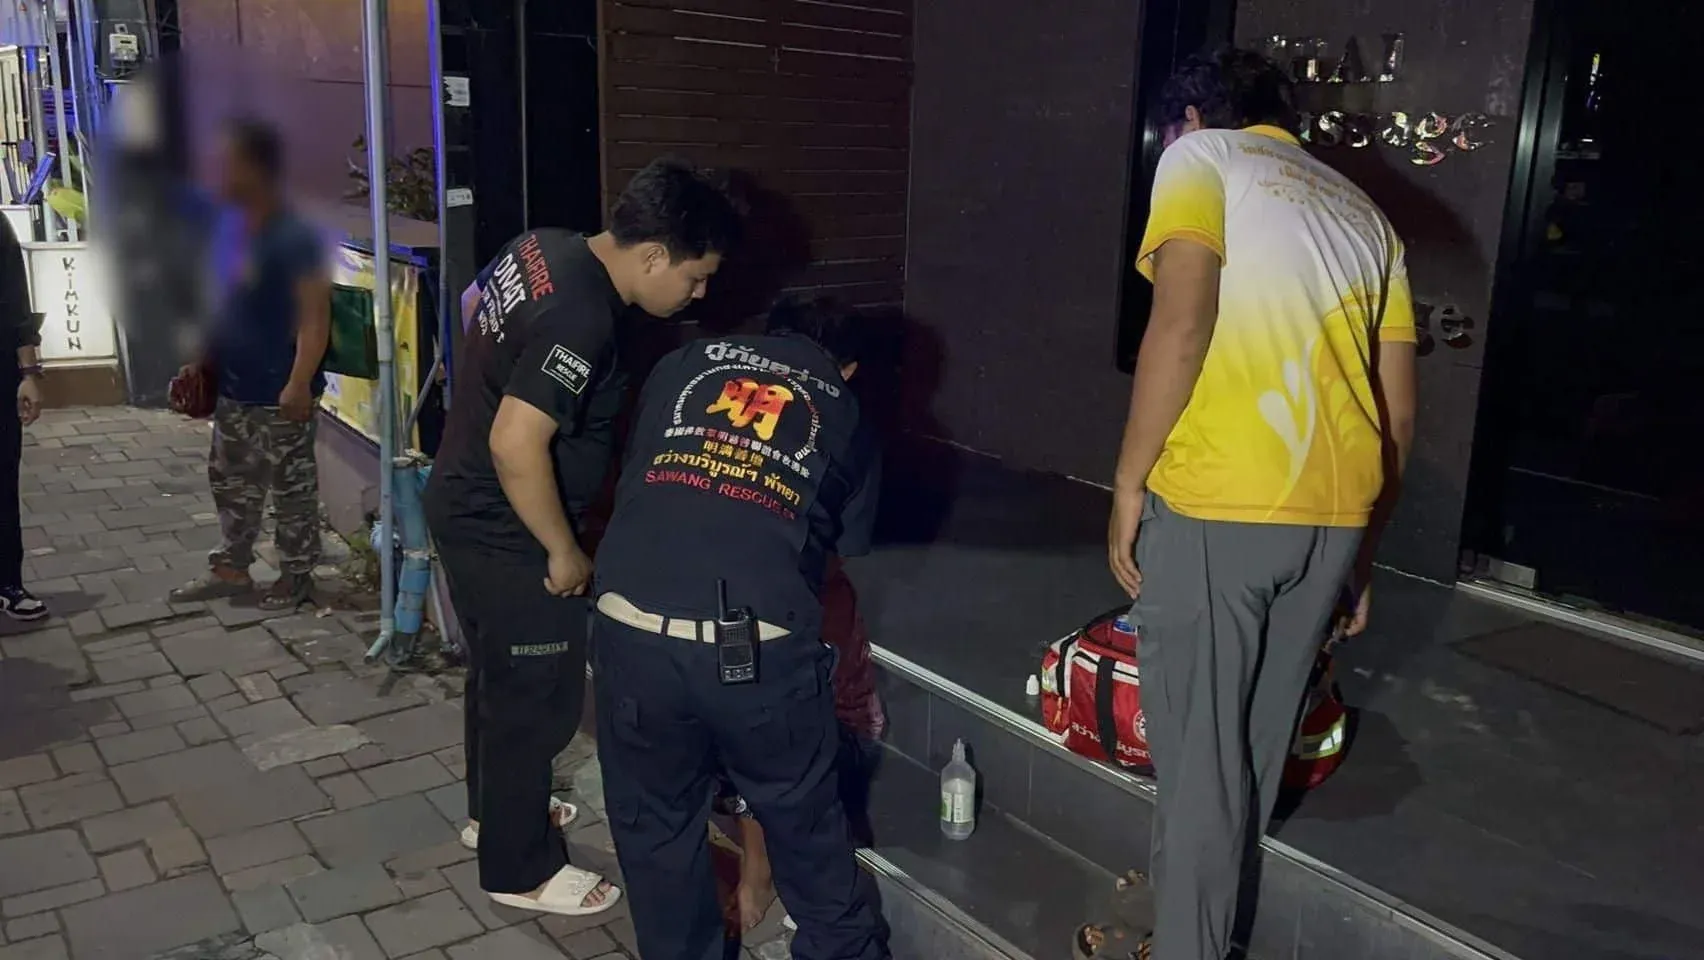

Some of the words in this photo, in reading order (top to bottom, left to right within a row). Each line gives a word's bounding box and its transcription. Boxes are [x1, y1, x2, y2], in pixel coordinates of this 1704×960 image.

[1300, 111, 1497, 166] ssage
[517, 233, 556, 302] THAIFIRE
[553, 348, 592, 378] THAIFIRE
[644, 469, 712, 491] SAWANG
